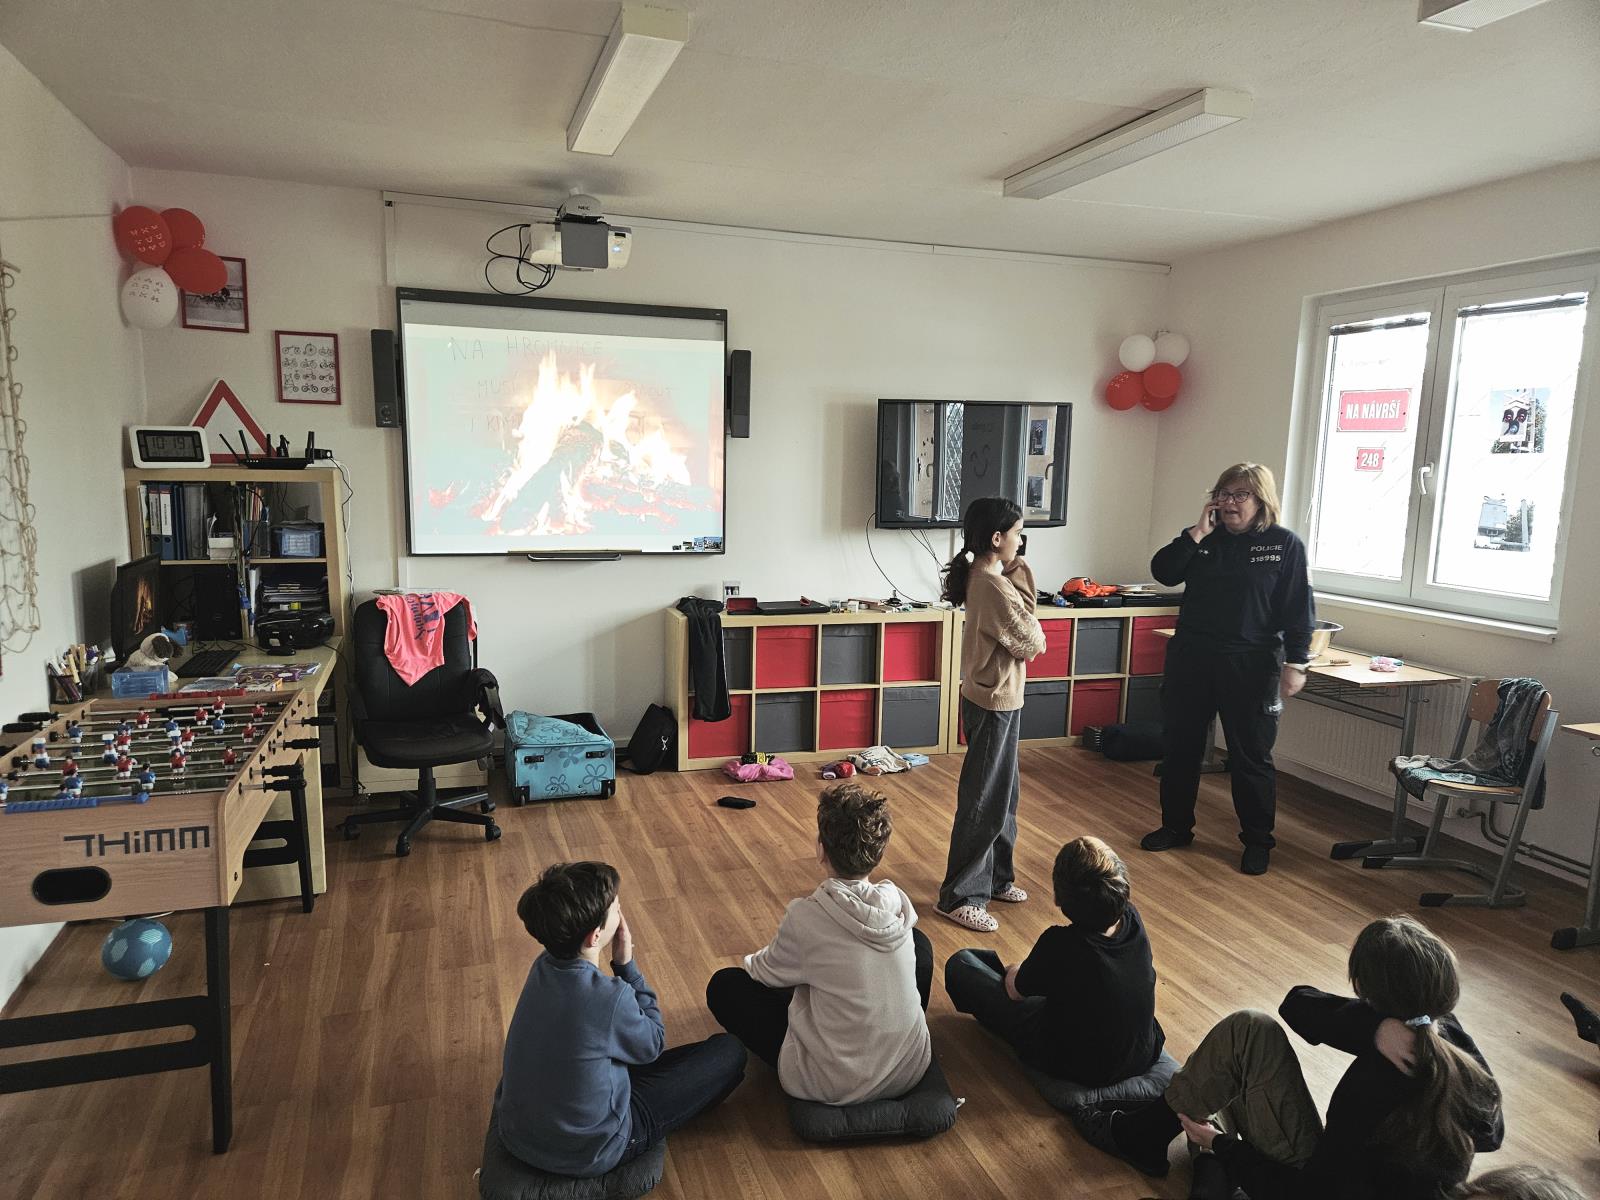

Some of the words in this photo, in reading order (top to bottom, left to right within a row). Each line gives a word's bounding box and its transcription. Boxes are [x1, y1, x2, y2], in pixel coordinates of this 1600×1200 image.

[450, 337, 484, 361] NA
[1345, 403, 1360, 419] NA
[1361, 399, 1401, 419] NÁVRŠÍ
[1361, 452, 1380, 467] 248
[1250, 544, 1283, 552] POLICIE
